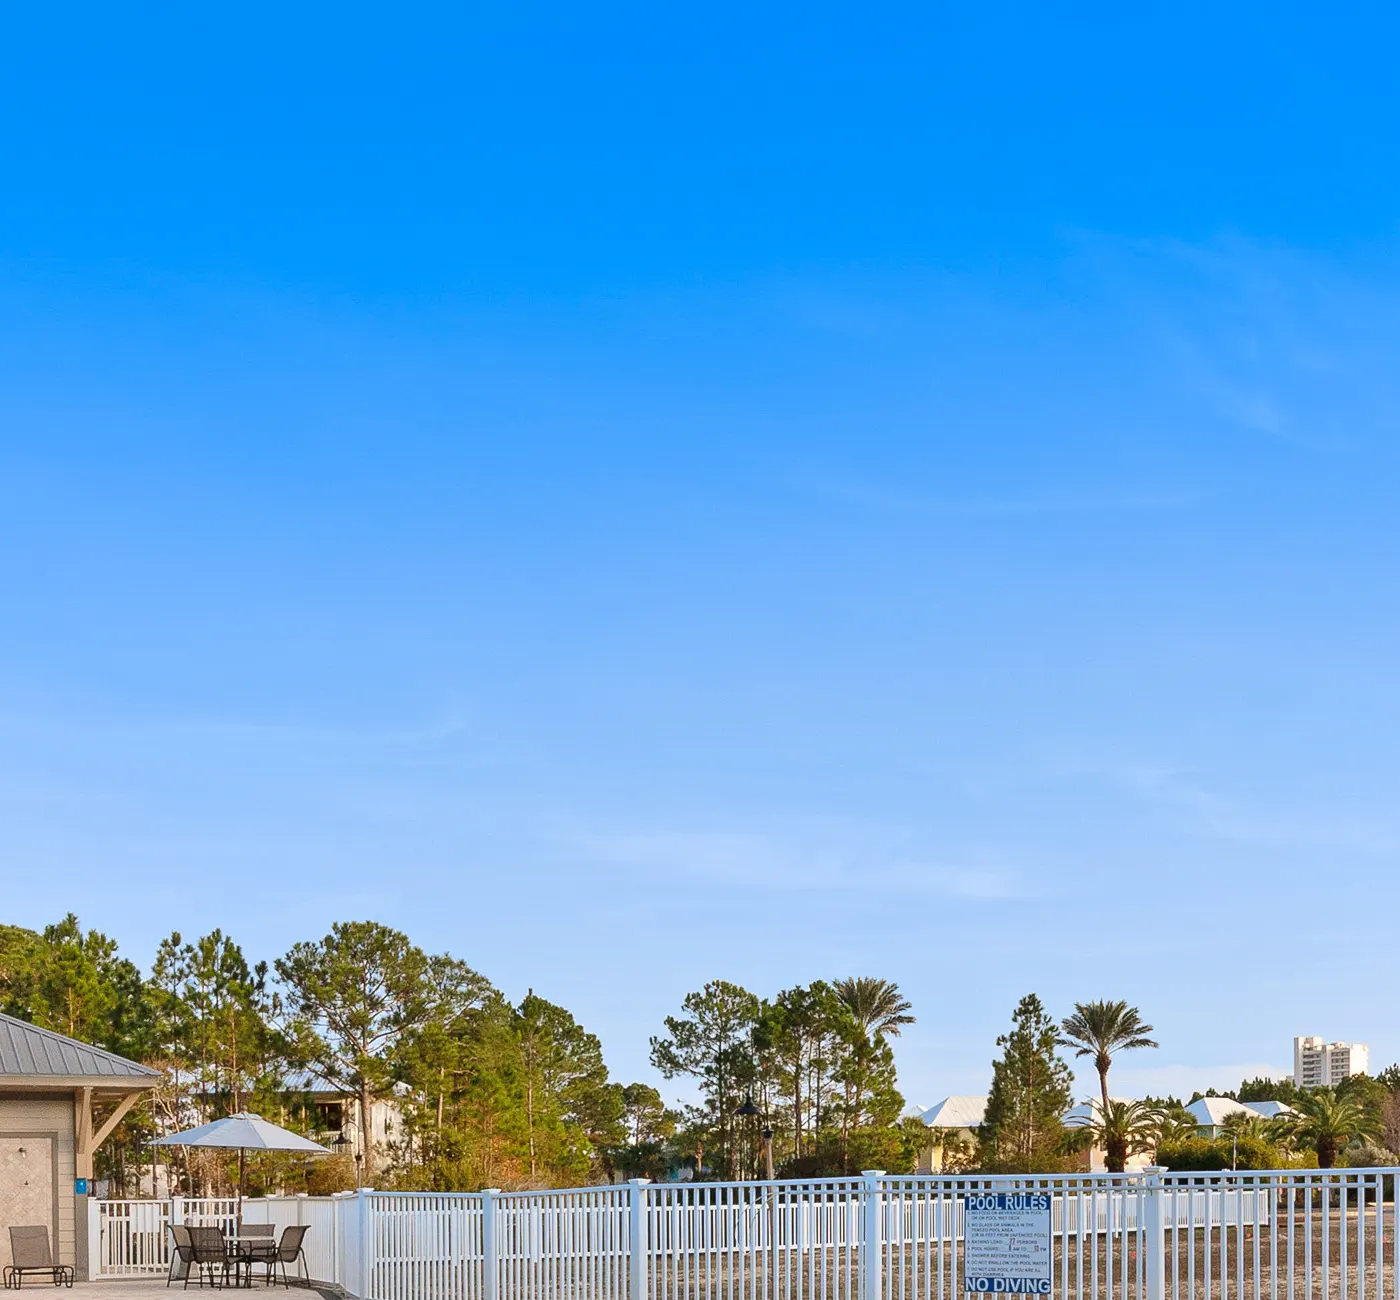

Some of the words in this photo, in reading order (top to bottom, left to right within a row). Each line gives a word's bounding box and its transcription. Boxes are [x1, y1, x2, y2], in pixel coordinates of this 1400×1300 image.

[968, 1196, 1002, 1210] POOL
[1006, 1196, 1047, 1210] RULES
[966, 1277, 989, 1291] NO
[994, 1278, 1050, 1293] DIVING
